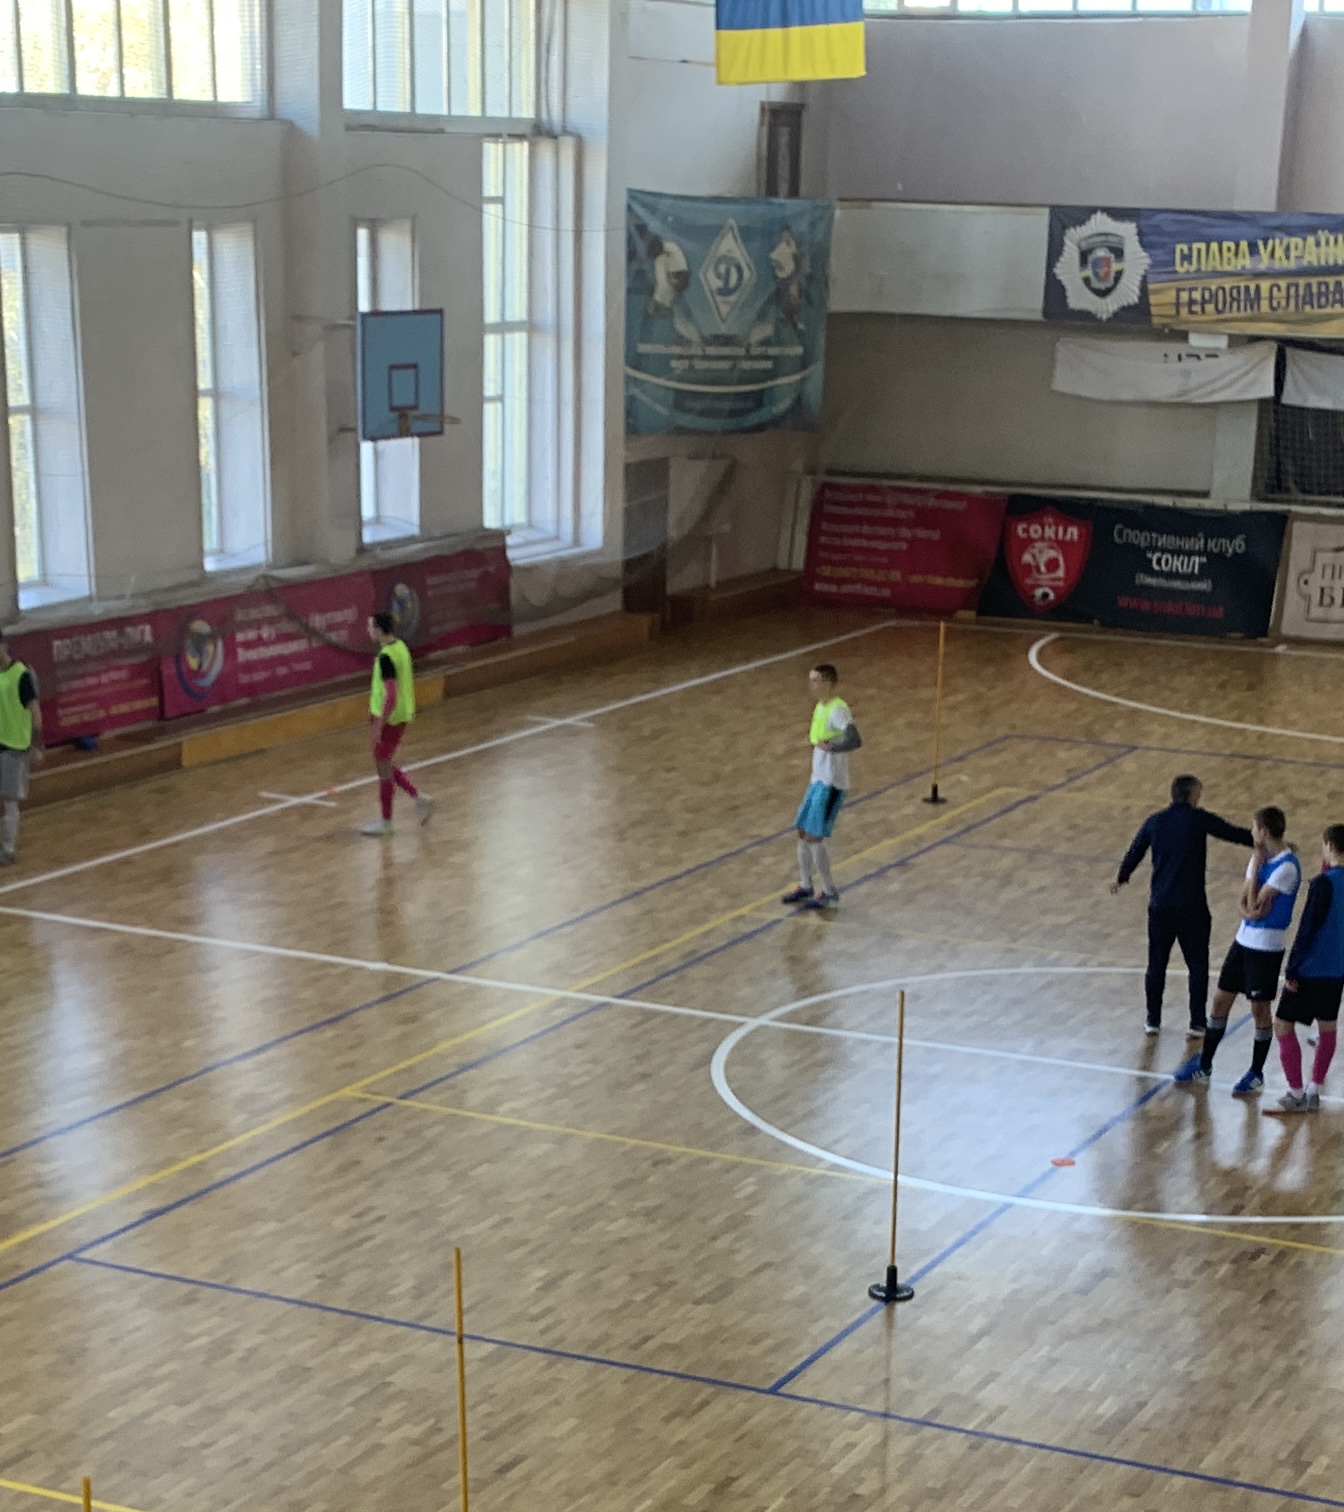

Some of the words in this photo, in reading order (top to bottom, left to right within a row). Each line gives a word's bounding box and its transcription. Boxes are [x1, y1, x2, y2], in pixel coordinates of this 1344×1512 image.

[1175, 240, 1251, 273] СЛАВА
[1175, 283, 1261, 316] ГЕРОЯМ
[1017, 521, 1079, 542] СОКІЛ
[1113, 523, 1205, 552] Спортивний
[1206, 533, 1247, 559] клуб
